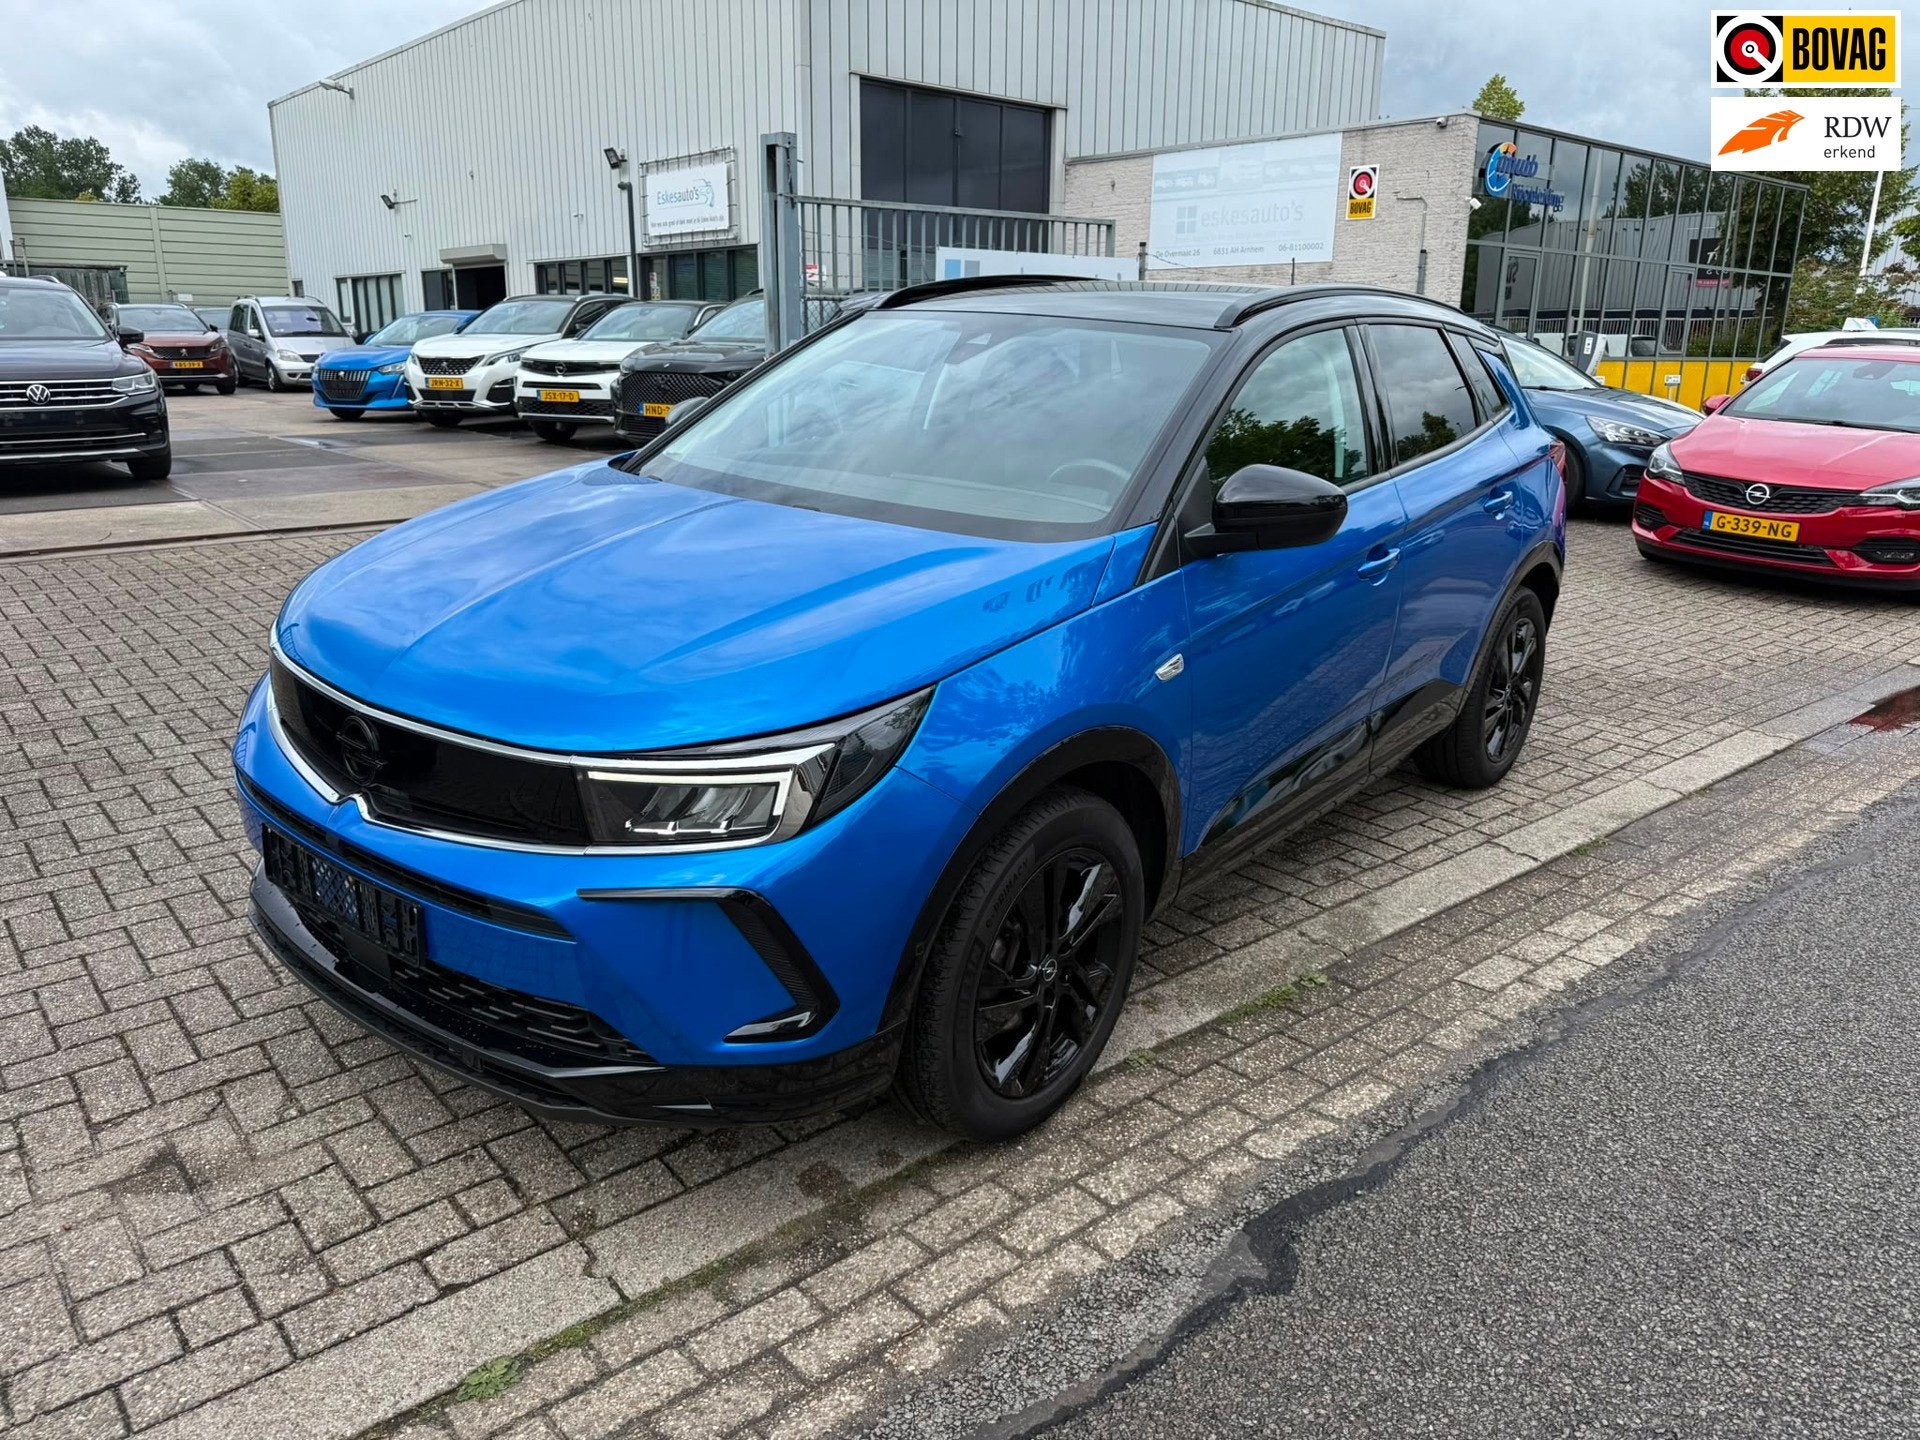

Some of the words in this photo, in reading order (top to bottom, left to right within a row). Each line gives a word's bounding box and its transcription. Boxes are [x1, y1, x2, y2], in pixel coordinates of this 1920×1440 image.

[657, 186, 700, 205] Eskesauto's
[1201, 200, 1304, 228] eskesauto's
[1350, 201, 1371, 214] BOVAG
[1716, 515, 1792, 538] G-339-NG
